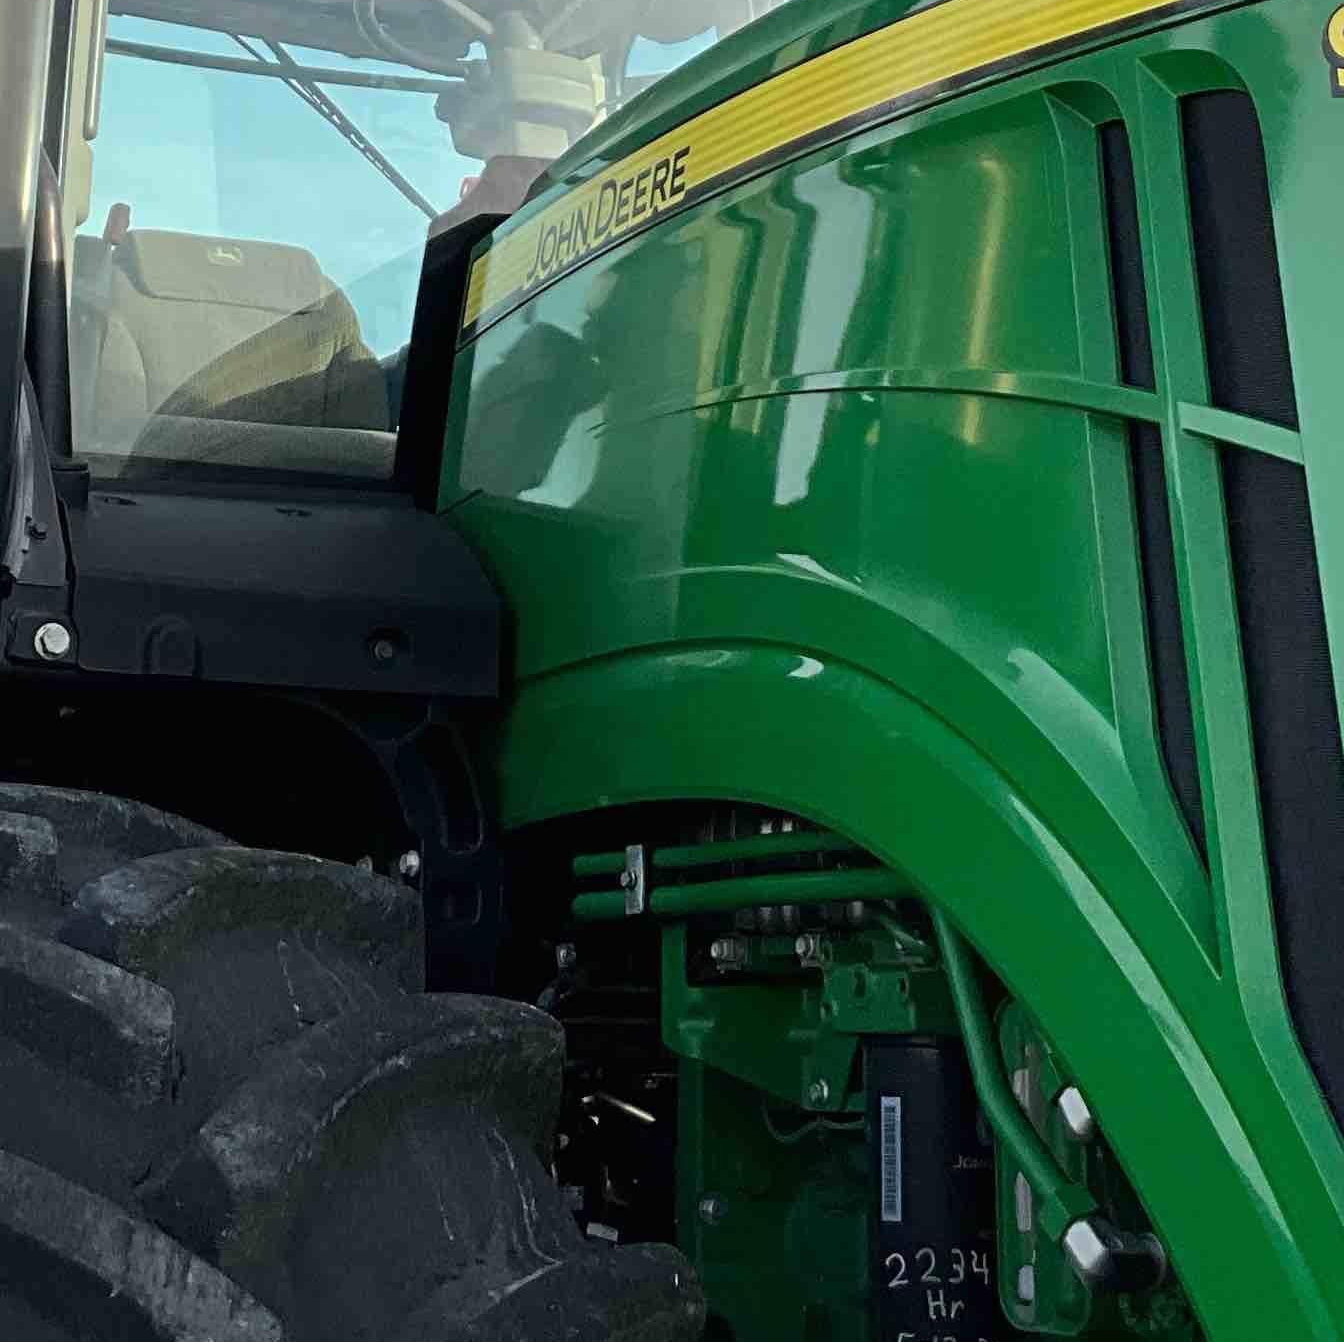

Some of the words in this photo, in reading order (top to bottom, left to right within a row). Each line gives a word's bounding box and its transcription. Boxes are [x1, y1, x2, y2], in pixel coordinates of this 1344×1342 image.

[526, 201, 592, 280] JOHN
[595, 146, 691, 236] DEERE
[884, 1247, 989, 1288] 2234
[926, 1289, 965, 1320] Hr
